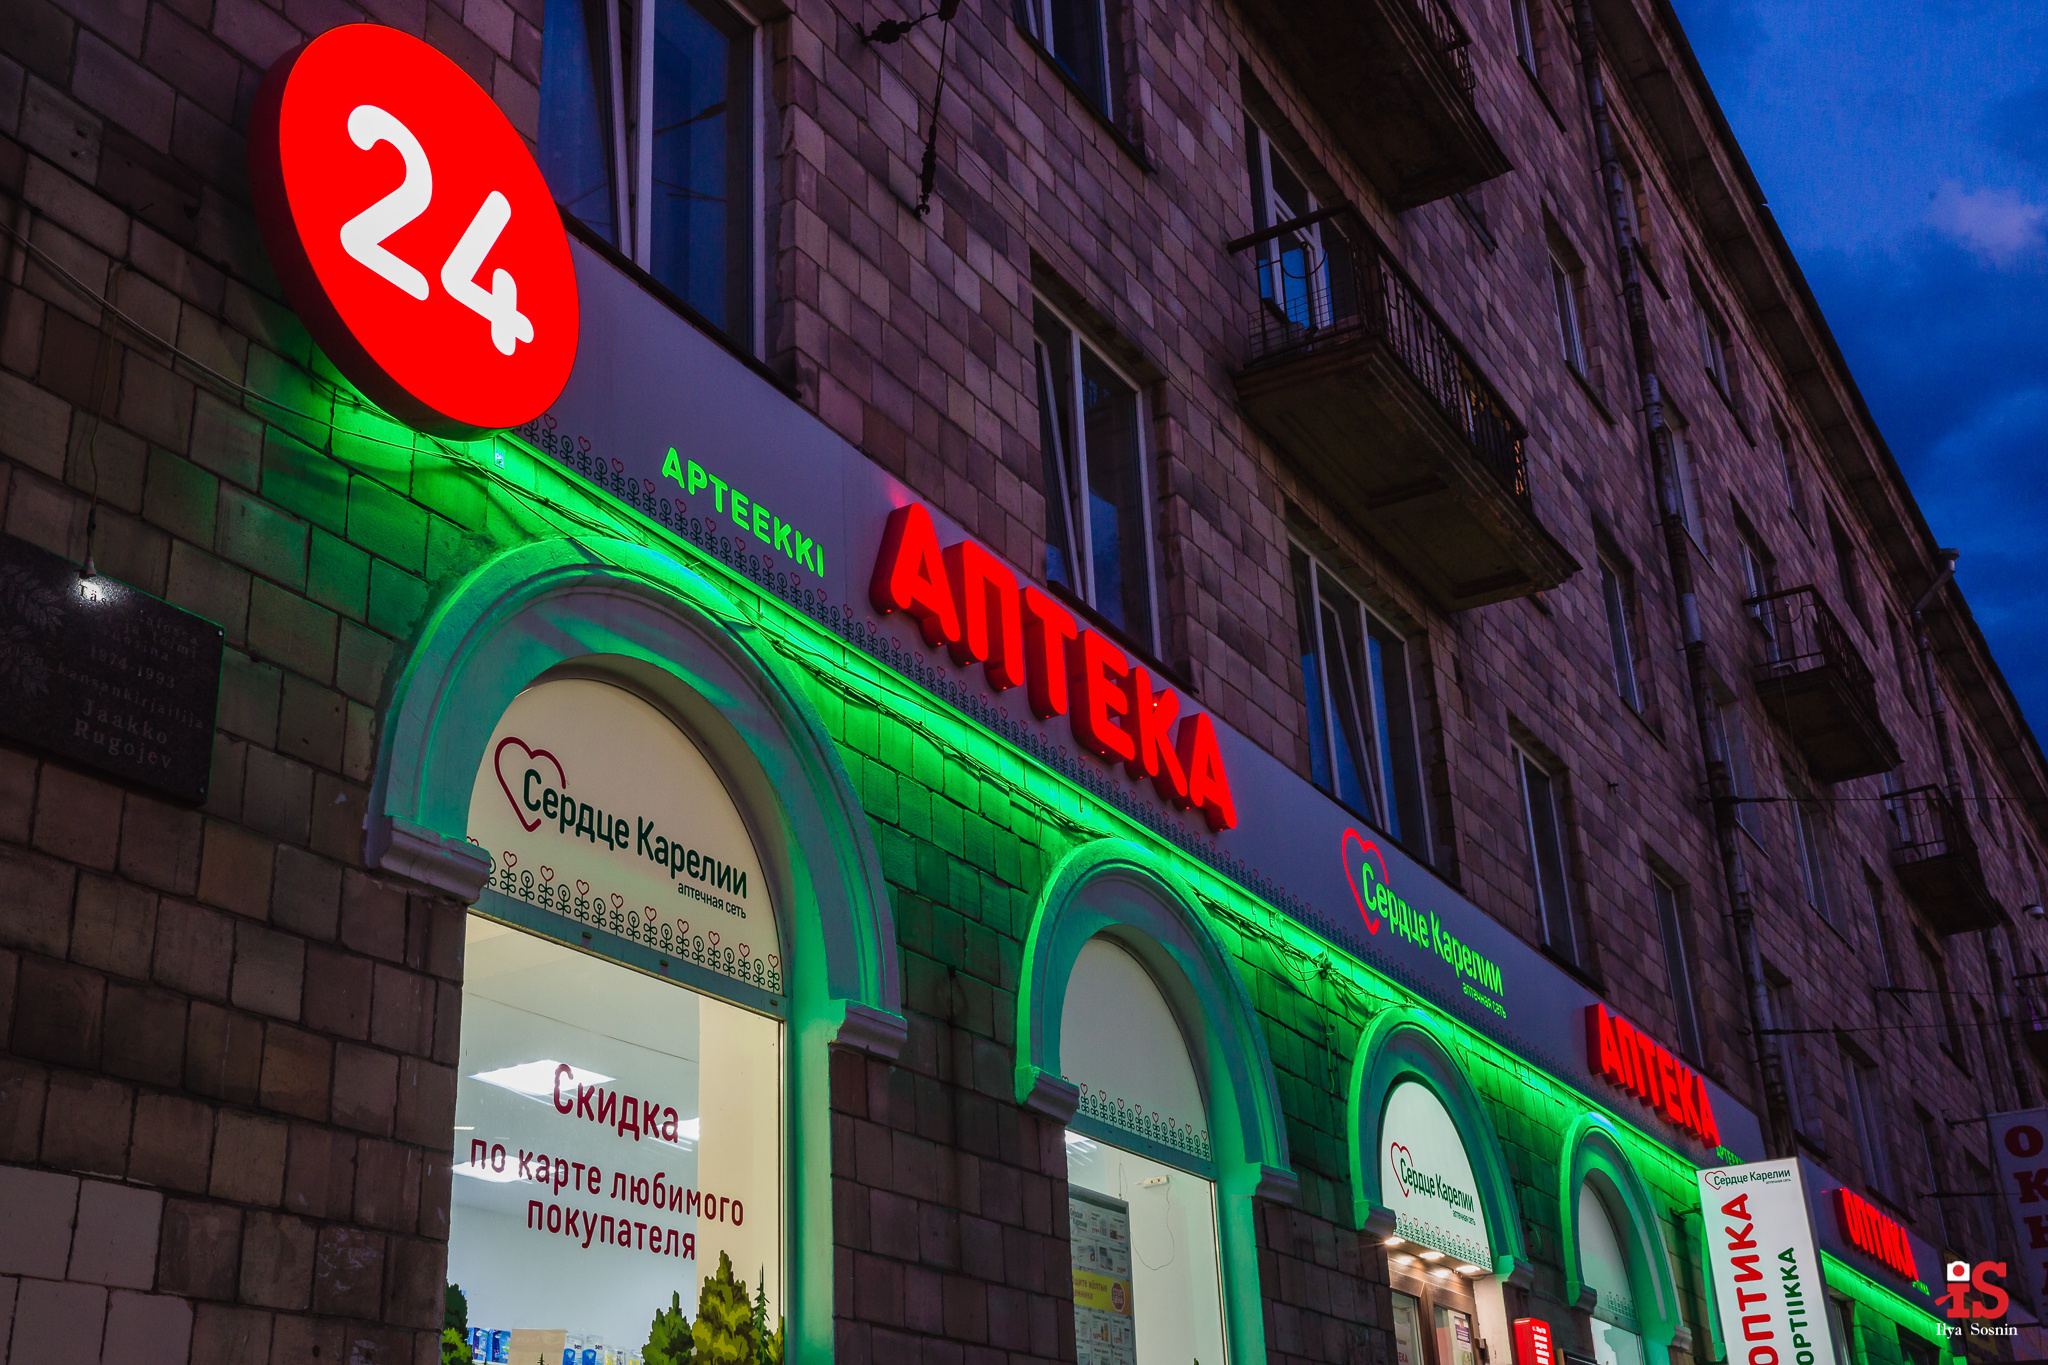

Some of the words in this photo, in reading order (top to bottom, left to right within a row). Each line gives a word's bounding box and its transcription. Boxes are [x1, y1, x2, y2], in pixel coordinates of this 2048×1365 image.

[340, 104, 534, 356] 24
[661, 446, 824, 578] APTEEKKI
[89, 644, 176, 689] 1974-1993
[870, 502, 1237, 831] АПТЕКА
[74, 717, 173, 769] Rugojev
[83, 699, 168, 745] Jaakko
[523, 768, 630, 851] Сердце
[637, 816, 747, 899] Карелии
[677, 882, 724, 911] аптечная
[725, 902, 747, 919] сеть
[1362, 862, 1430, 950] Сердце
[1429, 910, 1504, 997] Карелии
[553, 1063, 680, 1143] Скидка
[1586, 1002, 1721, 1149] АПТЕКА
[470, 1138, 506, 1173] по
[518, 1149, 602, 1196] карте
[610, 1171, 744, 1227] любимого
[1400, 1156, 1436, 1198] Сердце
[1435, 1173, 1475, 1213] Карелии
[1713, 1173, 1748, 1186] Сердце
[1749, 1168, 1791, 1182] Карелии
[527, 1199, 696, 1261] покупателя
[1720, 1192, 1780, 1365] ОПТИКА
[1777, 1246, 1815, 1365] OPTIIKKA
